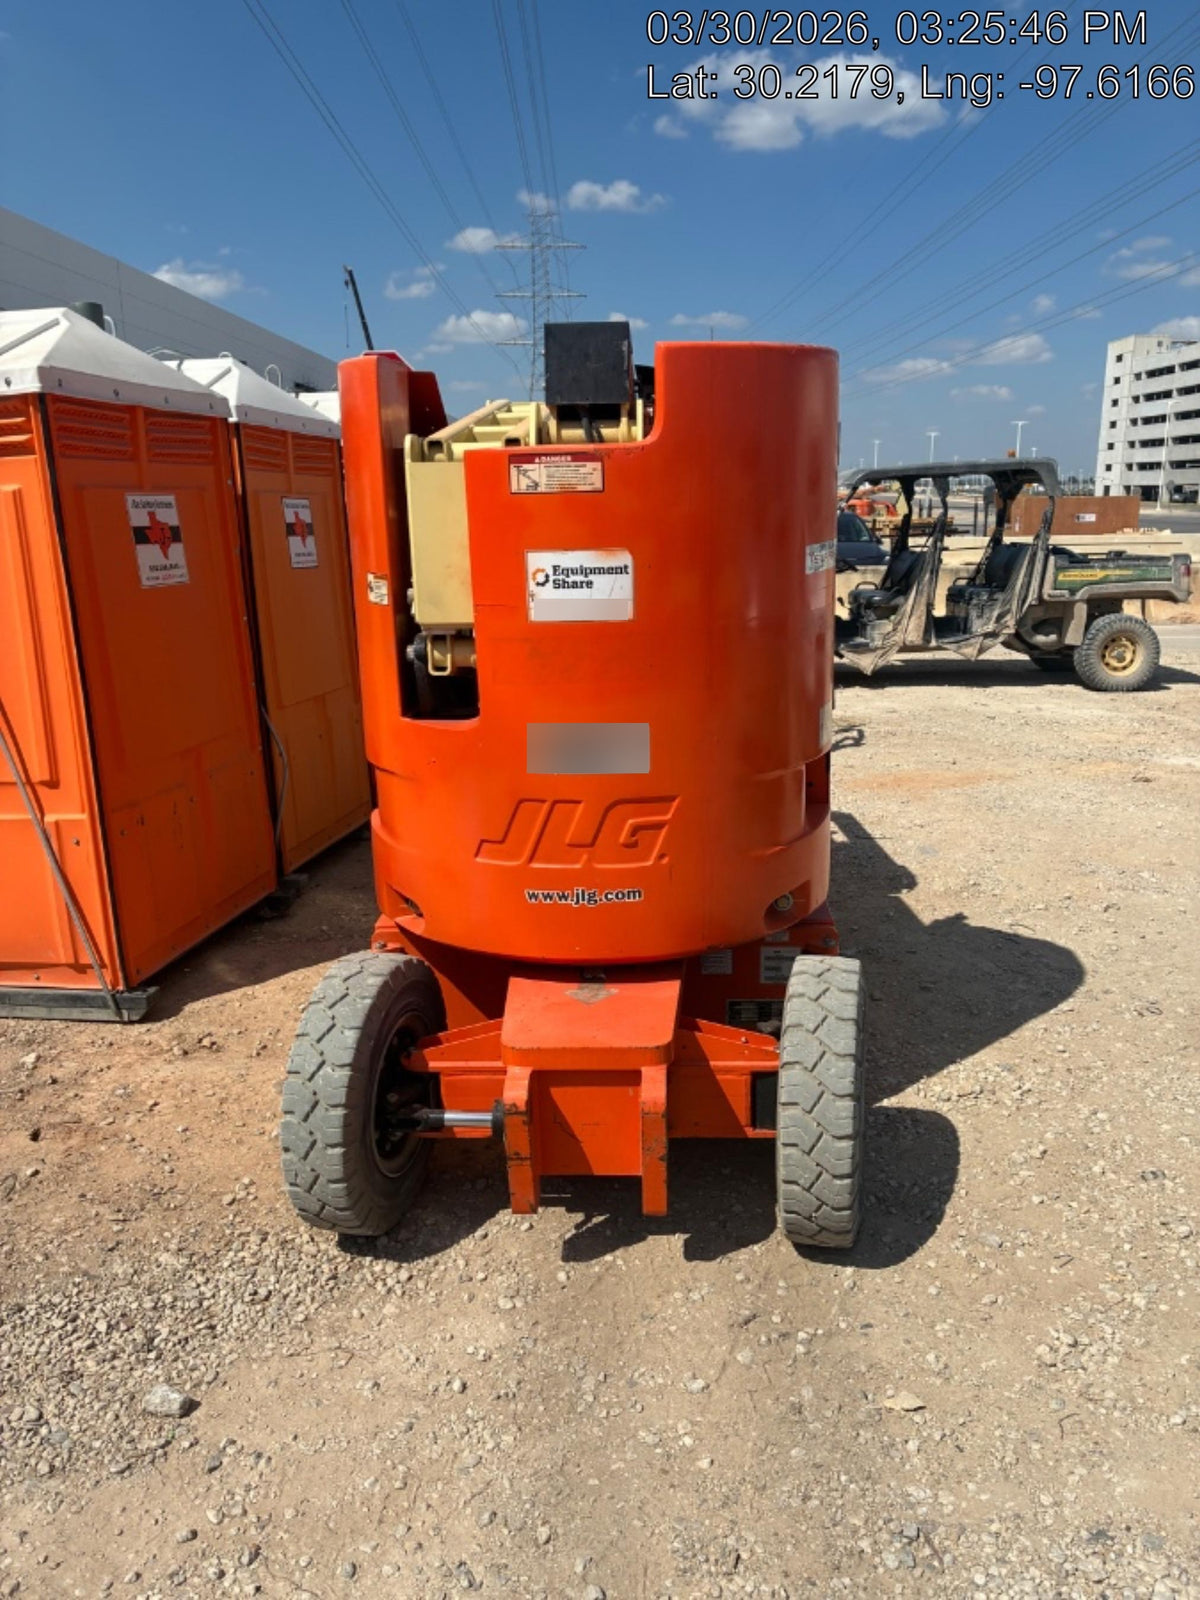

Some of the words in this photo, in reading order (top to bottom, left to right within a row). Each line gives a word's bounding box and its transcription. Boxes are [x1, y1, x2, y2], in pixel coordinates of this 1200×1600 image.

[551, 564, 630, 578] Equipment
[552, 578, 594, 589] Share
[525, 887, 643, 906] www.jlg.com
